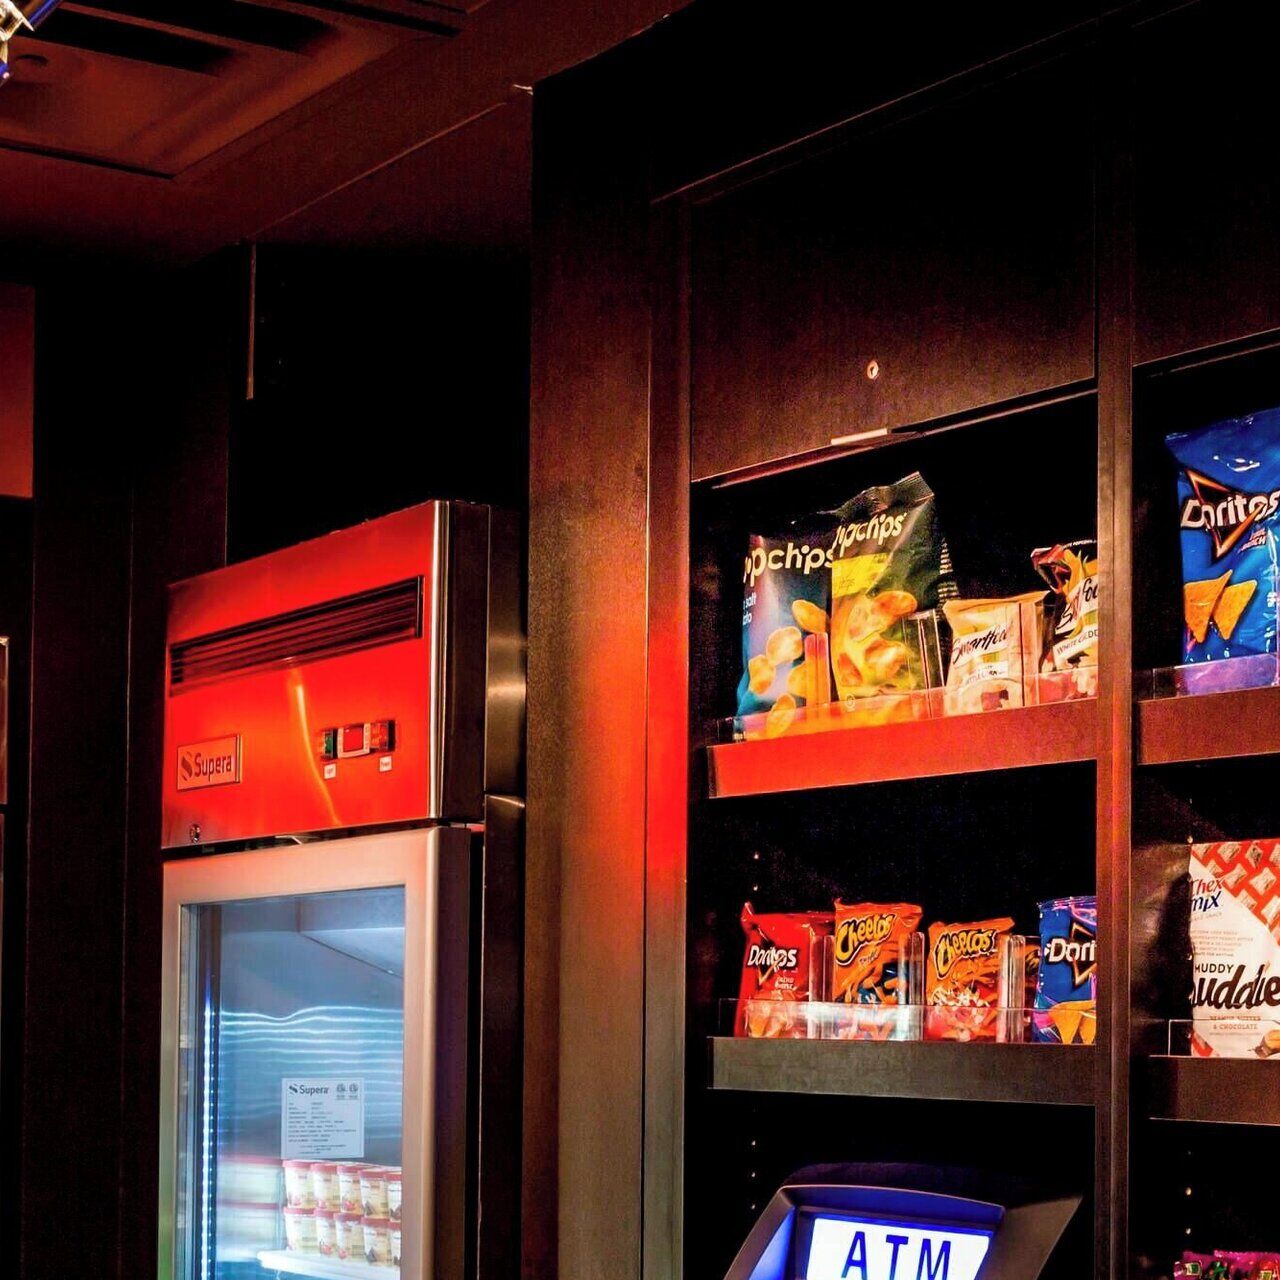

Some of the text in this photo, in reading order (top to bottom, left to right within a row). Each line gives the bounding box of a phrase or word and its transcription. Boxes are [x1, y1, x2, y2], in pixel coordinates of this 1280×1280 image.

[194, 753, 232, 781] Supera
[836, 913, 897, 964] Cheetos
[747, 945, 798, 968] Doritos
[935, 929, 997, 977] Cheetos
[299, 1084, 329, 1096] Supera
